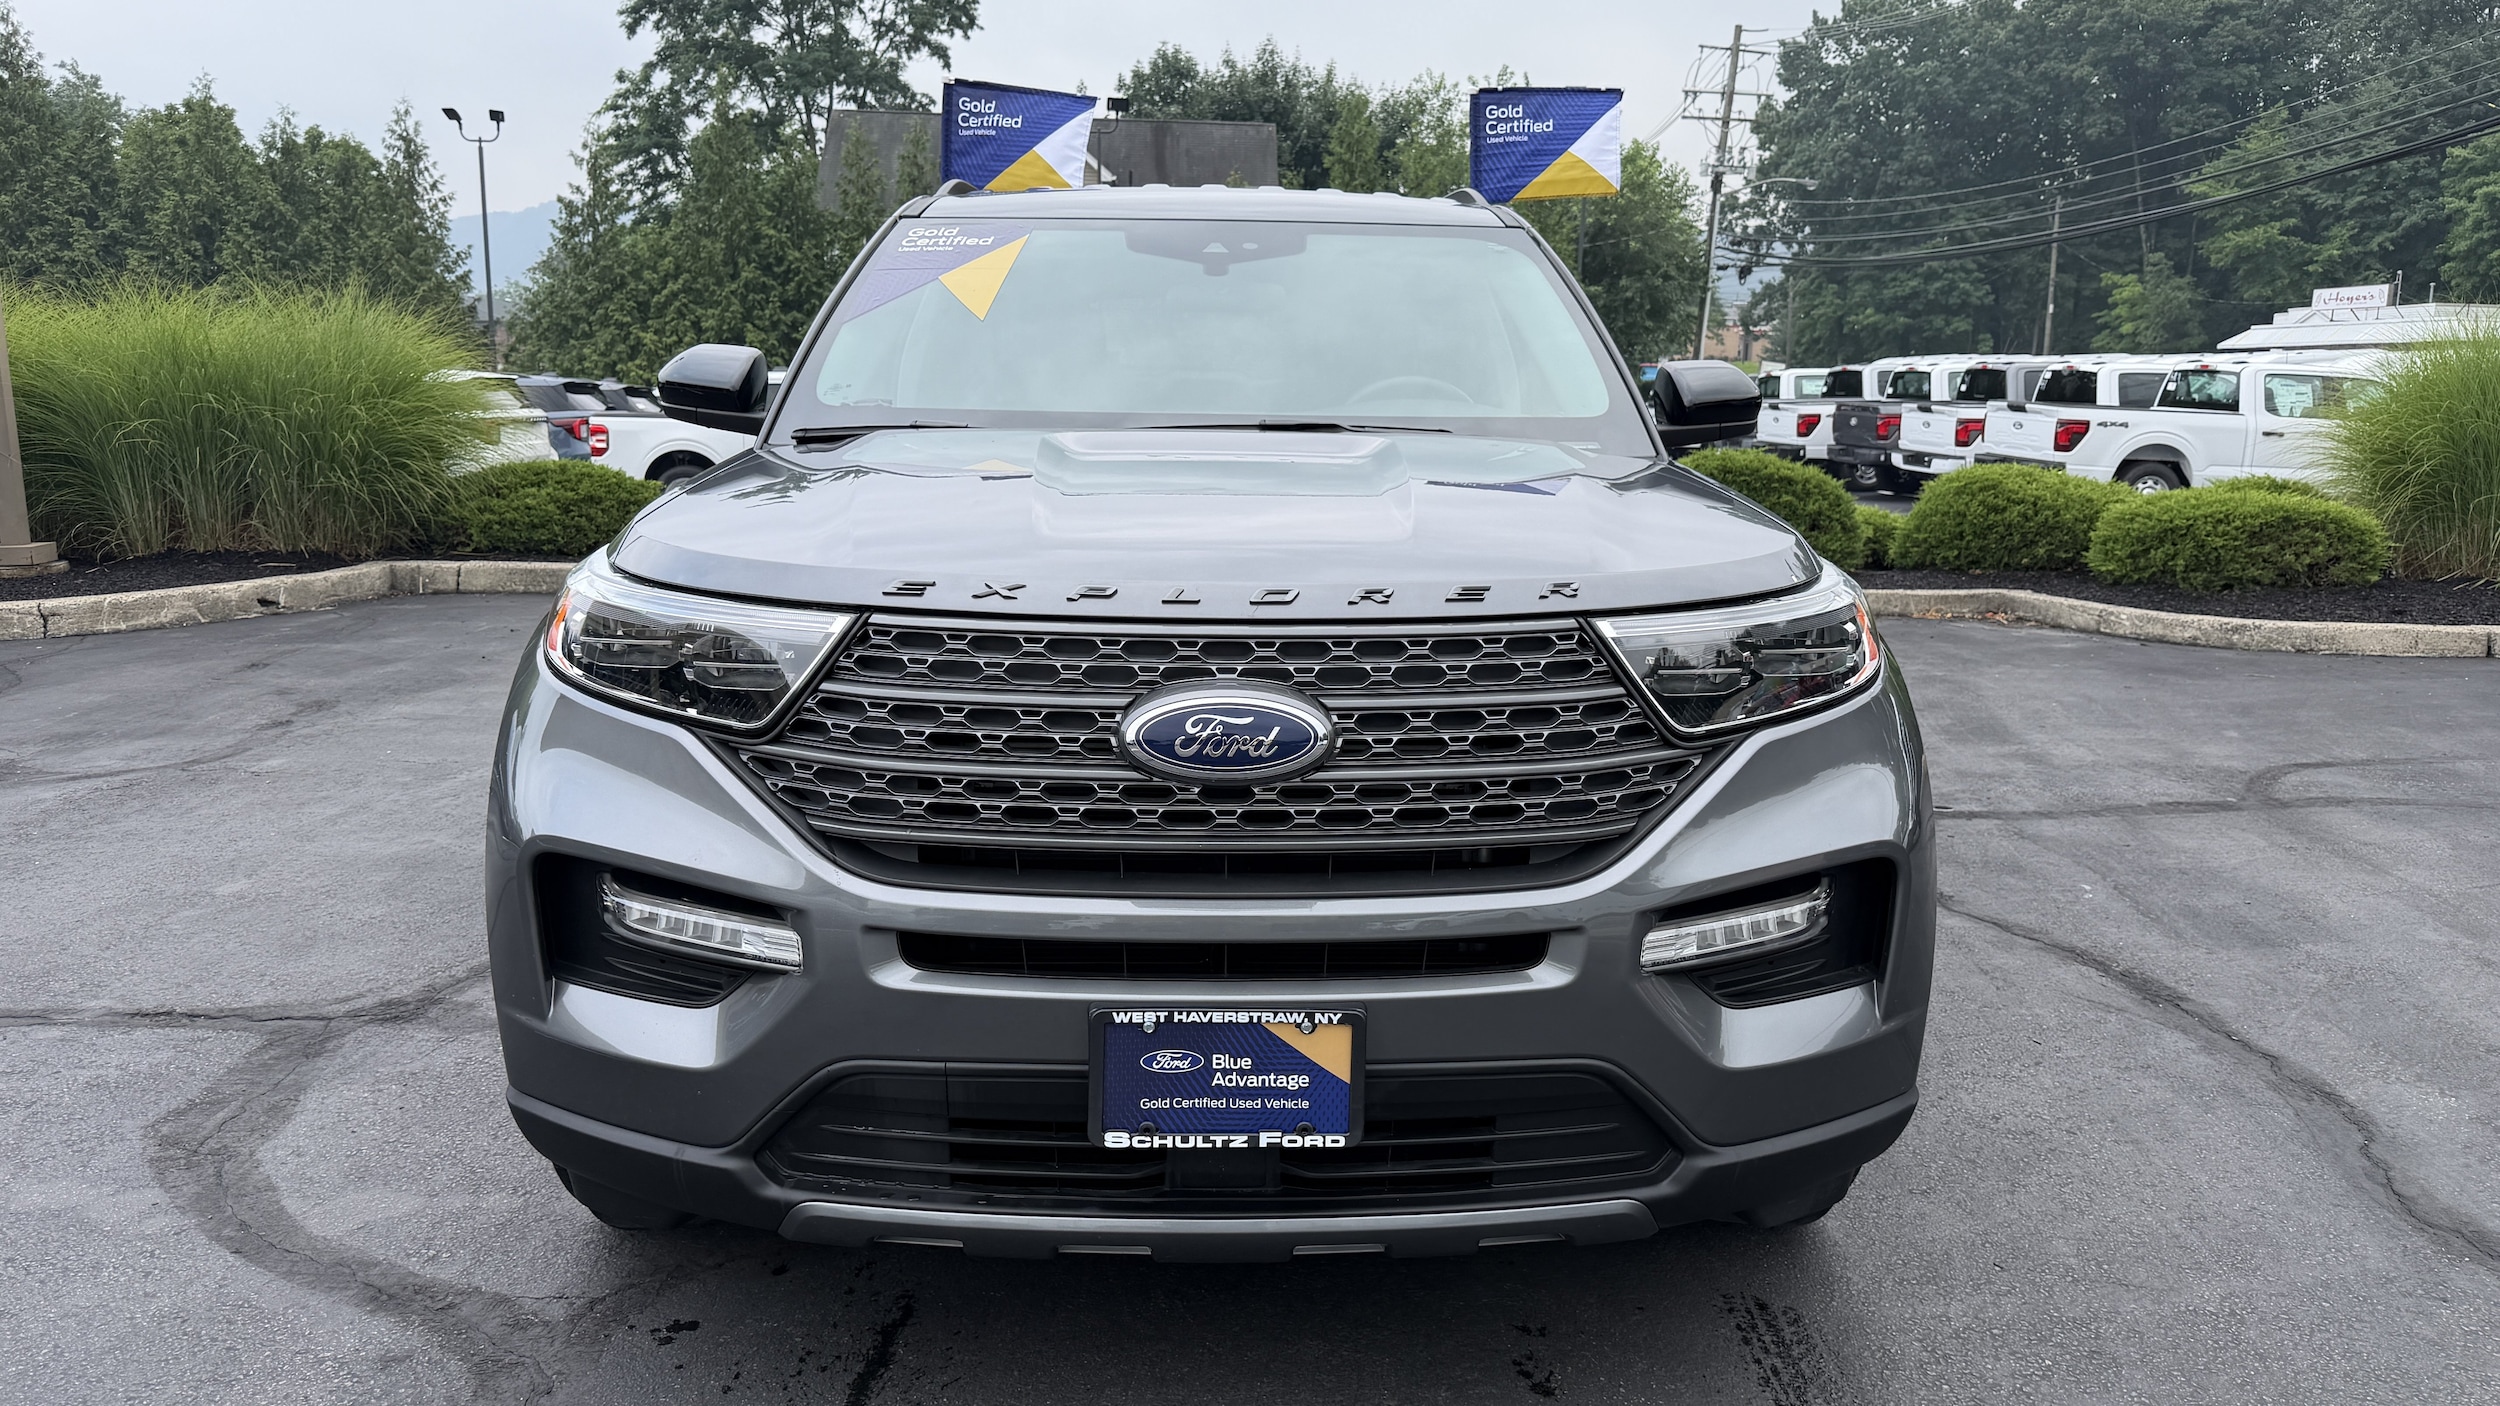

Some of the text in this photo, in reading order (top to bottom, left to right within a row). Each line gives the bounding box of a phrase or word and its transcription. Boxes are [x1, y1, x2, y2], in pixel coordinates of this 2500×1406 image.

[958, 96, 996, 113] Gold
[1485, 104, 1523, 118] Gold
[957, 112, 1022, 128] Certified
[1485, 119, 1554, 134] Certified
[958, 128, 996, 136] Used Vehicle
[908, 227, 959, 236] Gold
[901, 236, 995, 246] Certified
[2323, 291, 2375, 304] Hoyer's
[882, 579, 1581, 606] EXPLORER
[1174, 713, 1281, 758] Ford
[1112, 1011, 1342, 1024] WEST HAVERSTRAW, NY
[1152, 1053, 1252, 1070] Ford Blue
[1211, 1072, 1310, 1090] Advantage
[1140, 1097, 1310, 1110] Gold Certified Used Vehicle
[1103, 1131, 1346, 1149] SCHULTZ FORD
